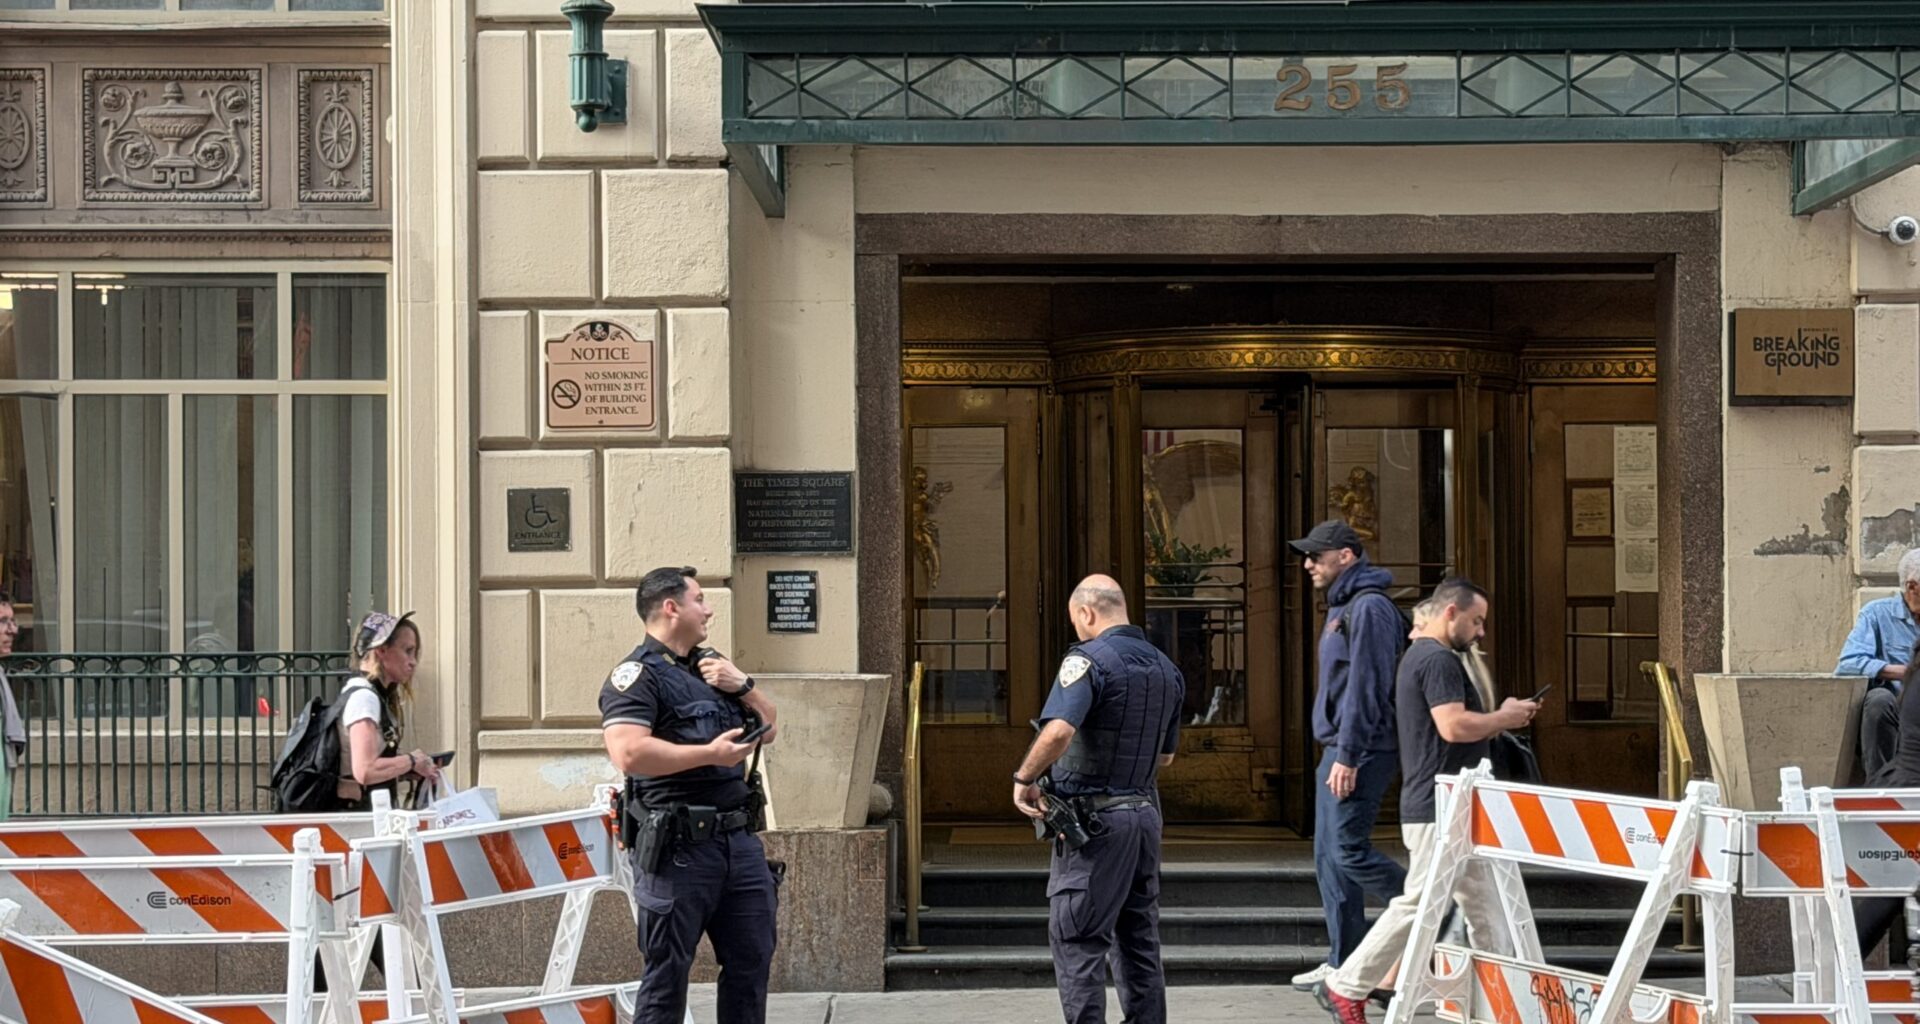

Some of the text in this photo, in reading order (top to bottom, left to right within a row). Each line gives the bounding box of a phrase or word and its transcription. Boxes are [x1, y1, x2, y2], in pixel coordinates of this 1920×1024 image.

[1274, 62, 1410, 111] 255
[1753, 328, 1840, 352] BREAKING
[571, 347, 630, 360] NOTICE
[1764, 351, 1840, 376] GROUND
[585, 371, 648, 380] NO SMOKING
[584, 383, 621, 392] WITHIN
[634, 383, 647, 391] FT.
[585, 394, 647, 403] OF BUILDING
[585, 406, 639, 415] ENTRANCE.
[743, 477, 846, 489] THE TIMES SQUARE
[514, 531, 562, 540] ENTRANCE
[169, 894, 231, 906] conEdison
